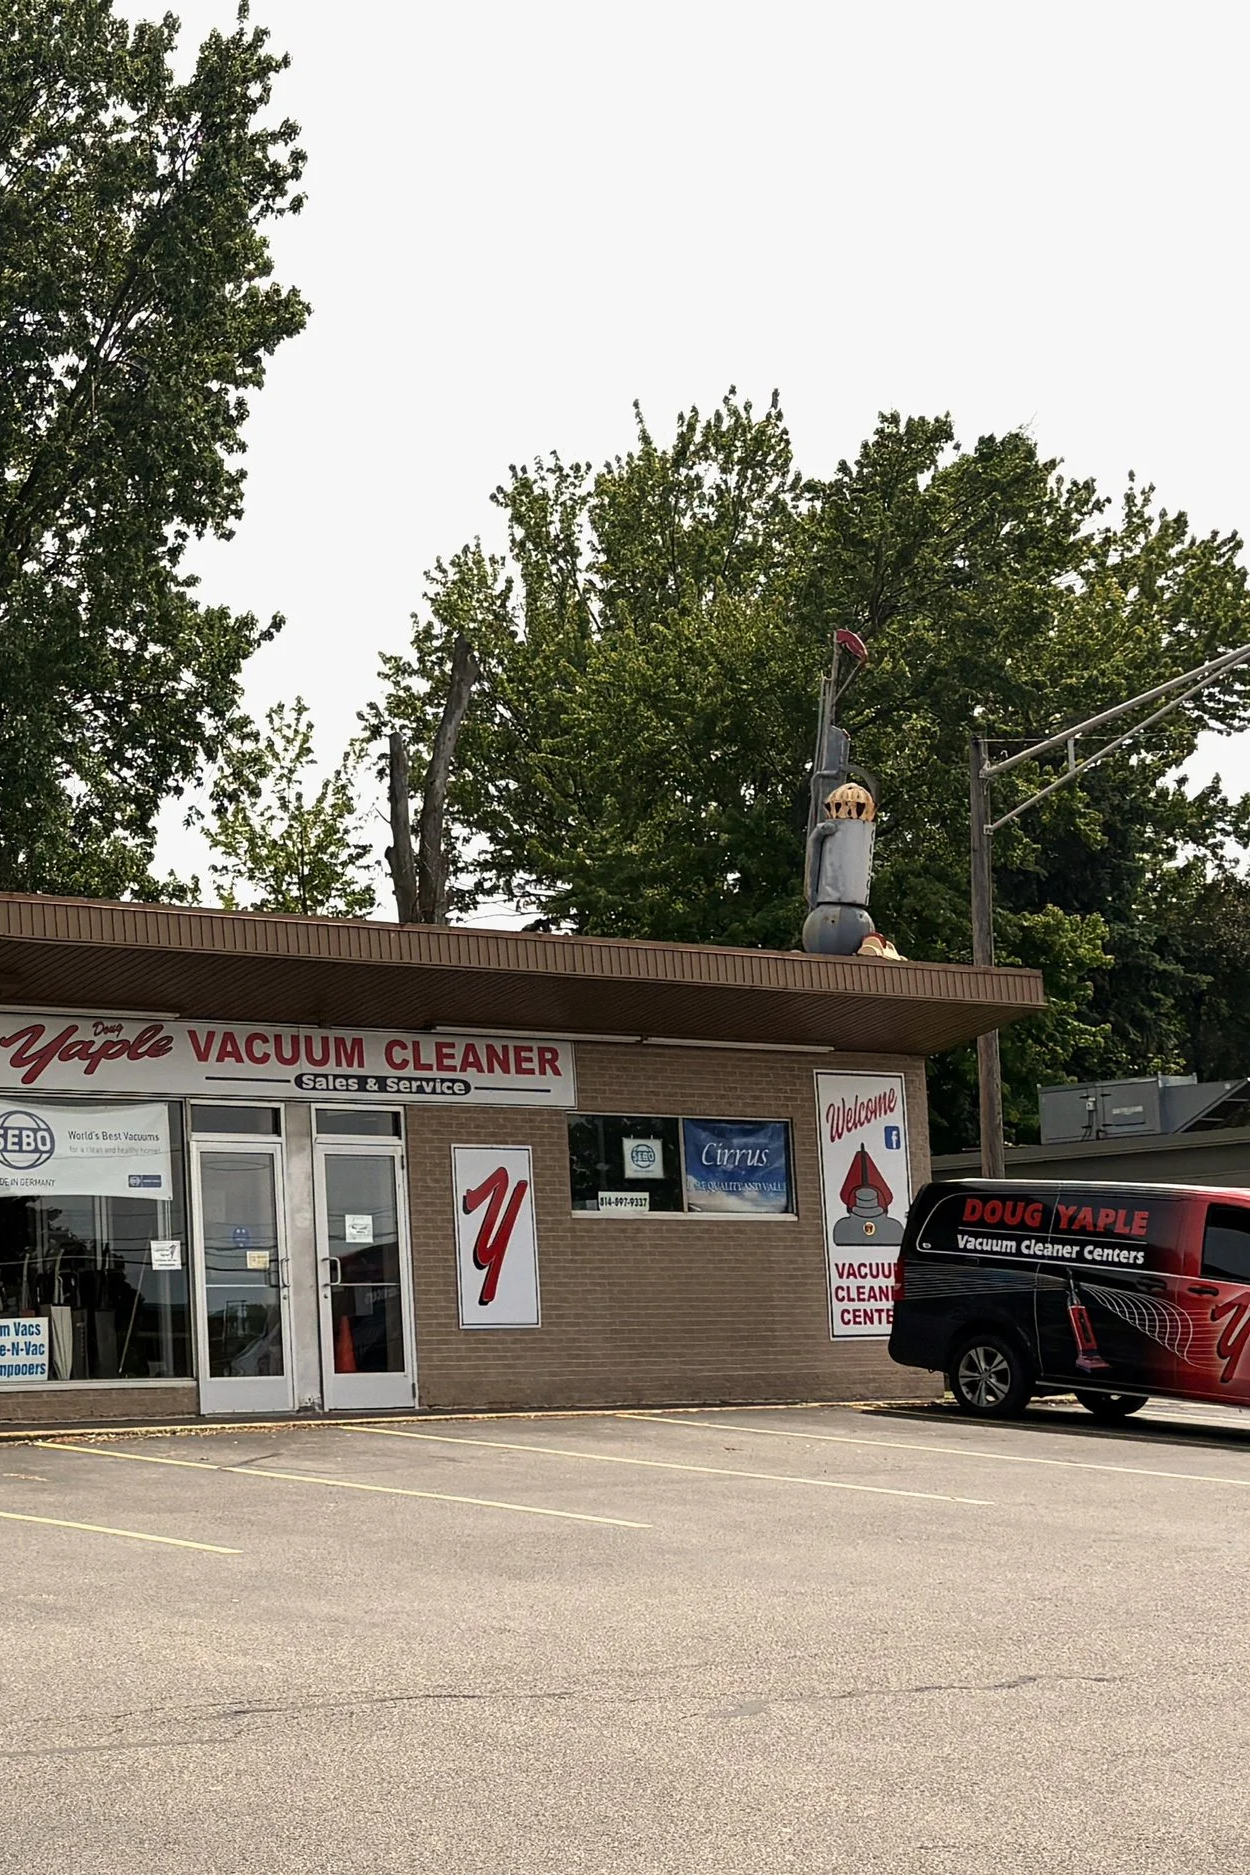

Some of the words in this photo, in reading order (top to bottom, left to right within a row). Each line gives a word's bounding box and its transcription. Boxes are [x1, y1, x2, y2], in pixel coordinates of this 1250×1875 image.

[92, 1021, 124, 1037] Doug
[0, 1024, 174, 1084] Yaple
[187, 1029, 365, 1069] VACUUM
[384, 1039, 562, 1076] CLEANER
[302, 1075, 359, 1091] Sales
[365, 1078, 379, 1091] &
[386, 1078, 466, 1094] Service
[826, 1087, 898, 1143] Welcome
[68, 1131, 100, 1141] World's
[102, 1131, 122, 1141] Best
[123, 1132, 160, 1142] Vacuums
[701, 1142, 770, 1167] Cirrus
[10, 1178, 19, 1187] IN
[19, 1178, 56, 1187] GERMANY
[963, 1198, 1043, 1227] DOUG
[1056, 1205, 1150, 1236] YAPLE
[957, 1234, 1017, 1253] Vacuum
[1021, 1239, 1080, 1259] Cleaner
[1083, 1245, 1145, 1265] Centers
[835, 1262, 897, 1280] VACUU
[834, 1285, 894, 1303] CLEAN
[840, 1308, 894, 1325] CENTE
[13, 1321, 41, 1337] Vacs
